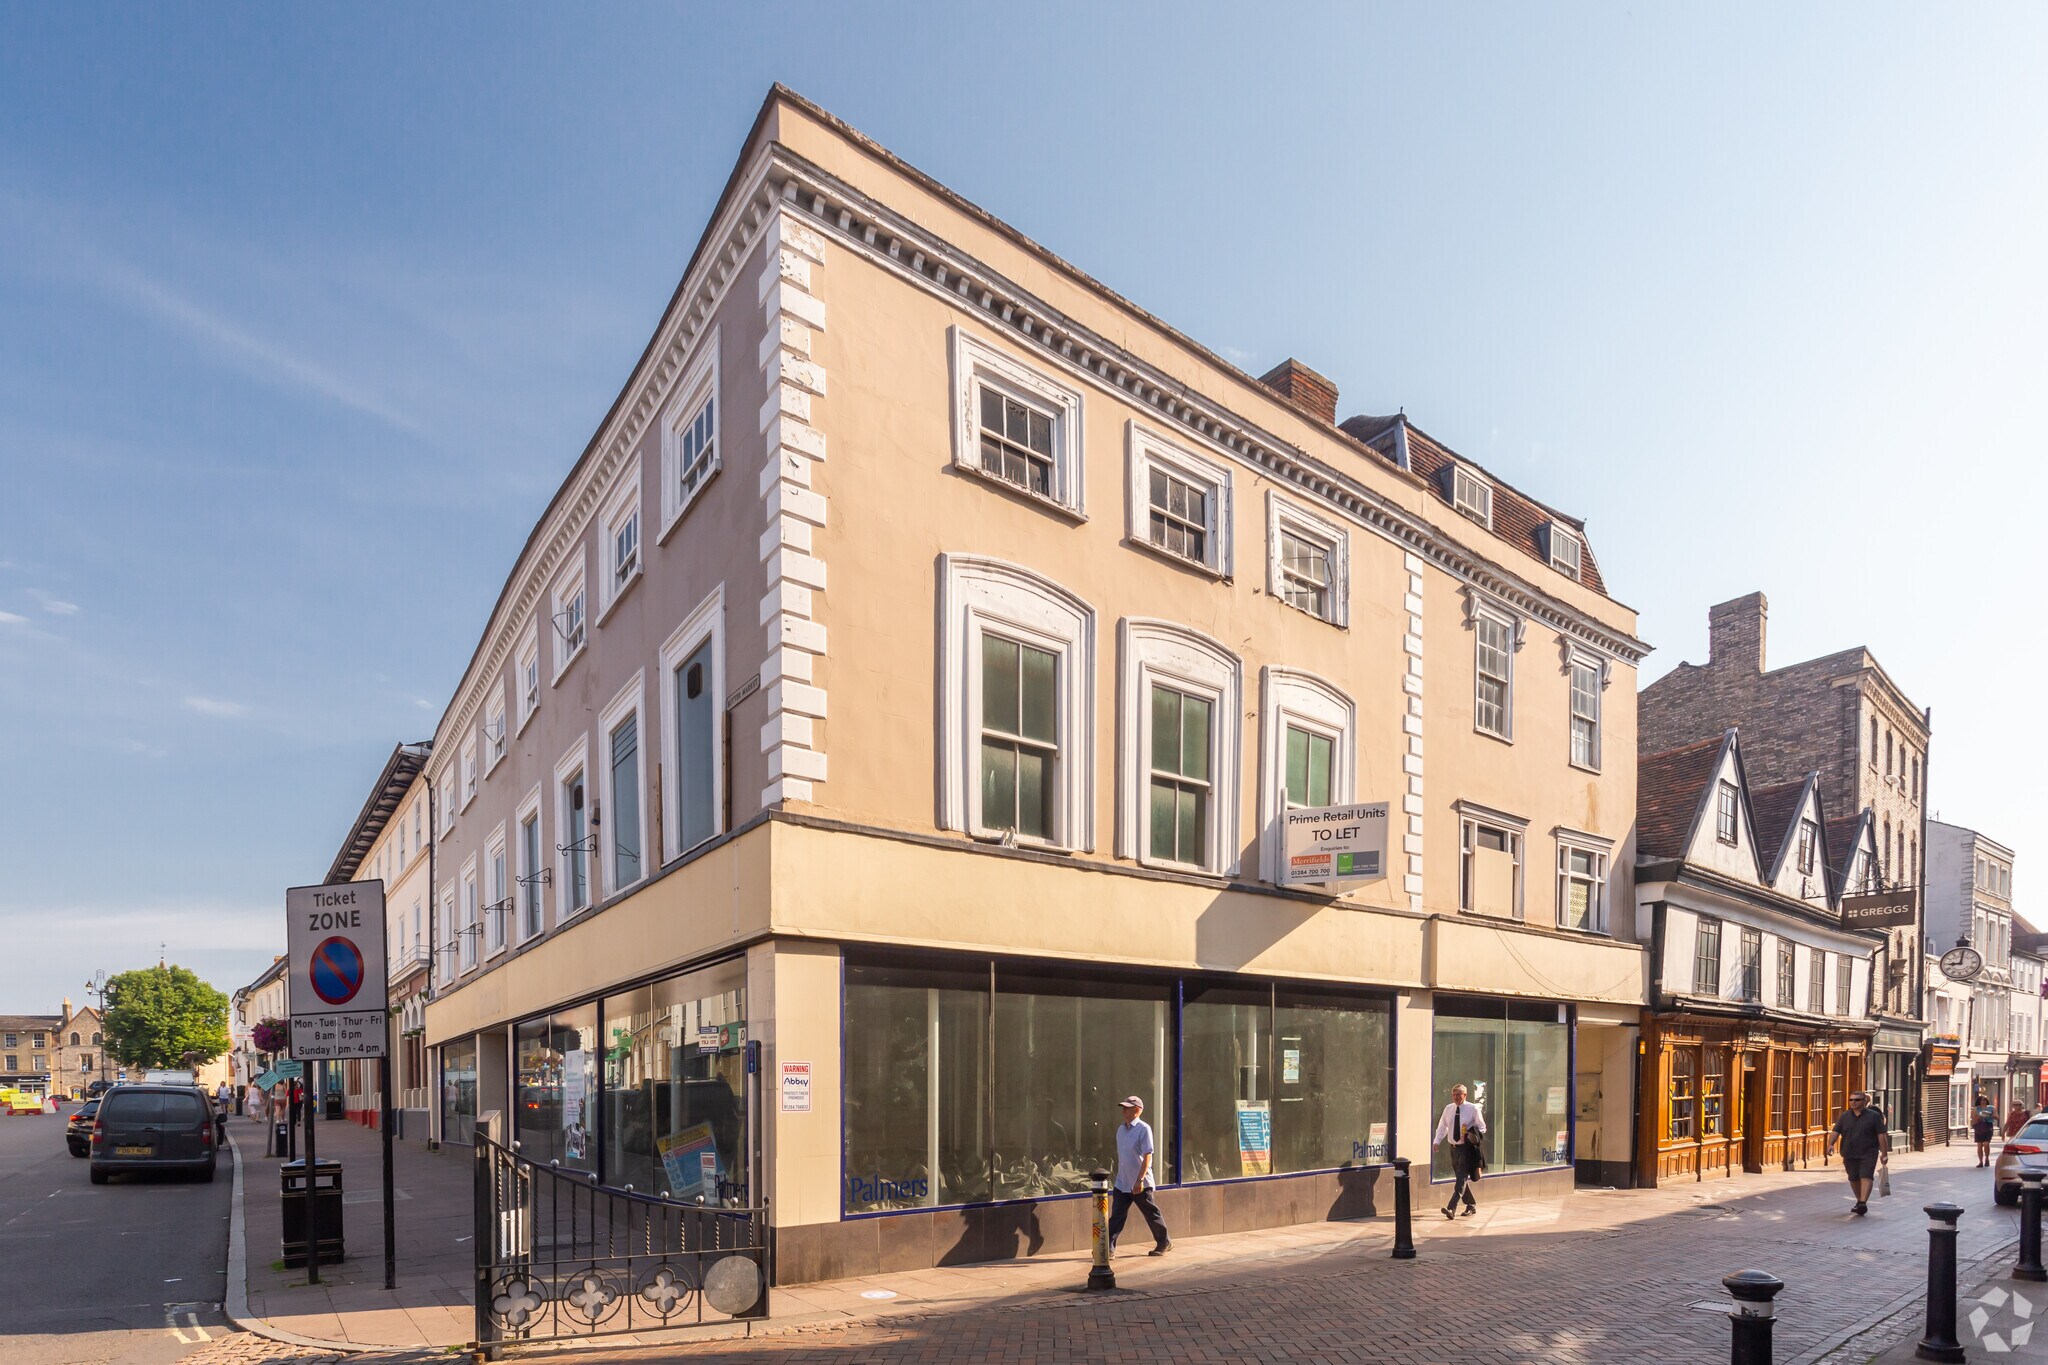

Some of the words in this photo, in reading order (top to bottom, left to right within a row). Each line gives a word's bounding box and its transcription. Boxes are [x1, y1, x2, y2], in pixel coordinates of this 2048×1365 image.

[742, 678, 759, 696] MARKET
[1289, 814, 1320, 825] Prime
[1324, 810, 1354, 821] Retail
[1357, 808, 1386, 819] Units
[1312, 829, 1332, 841] TO
[1336, 827, 1360, 839] LET
[1292, 855, 1330, 865] Merrifields
[313, 891, 356, 907] Ticket
[1859, 904, 1909, 917] GREGGS
[309, 910, 361, 931] ZONE
[294, 1020, 313, 1028] Mon
[343, 1017, 363, 1026] Thur
[370, 1015, 382, 1025] Fri
[314, 1031, 321, 1040] 8
[341, 1029, 347, 1039] 6
[348, 1031, 362, 1040] pm
[298, 1045, 330, 1056] Sunday
[357, 1043, 364, 1053] 4
[366, 1044, 379, 1054] pm
[783, 1065, 809, 1073] WARNING
[850, 1174, 928, 1203] Palmers
